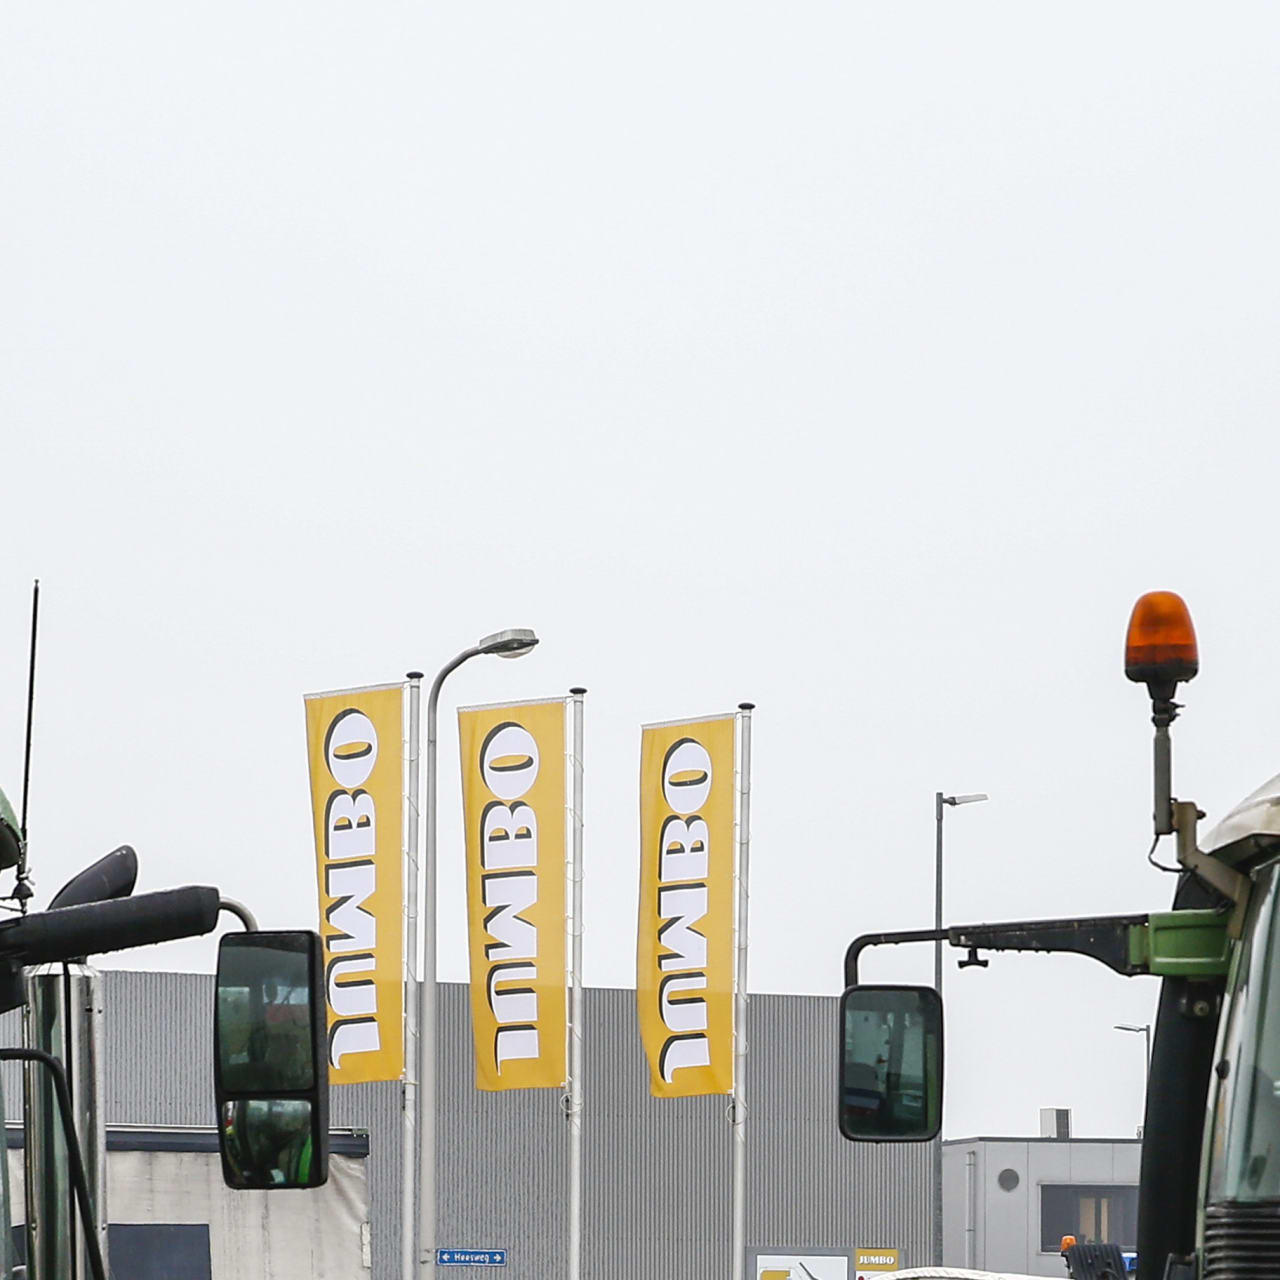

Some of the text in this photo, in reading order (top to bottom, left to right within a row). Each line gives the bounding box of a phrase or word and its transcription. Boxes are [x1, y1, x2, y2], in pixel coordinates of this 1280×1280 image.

[324, 707, 381, 1070] JUMBO
[479, 721, 540, 1077] JUMBO
[657, 736, 714, 1085] JUMBO
[858, 1255, 895, 1265] JUMBO
